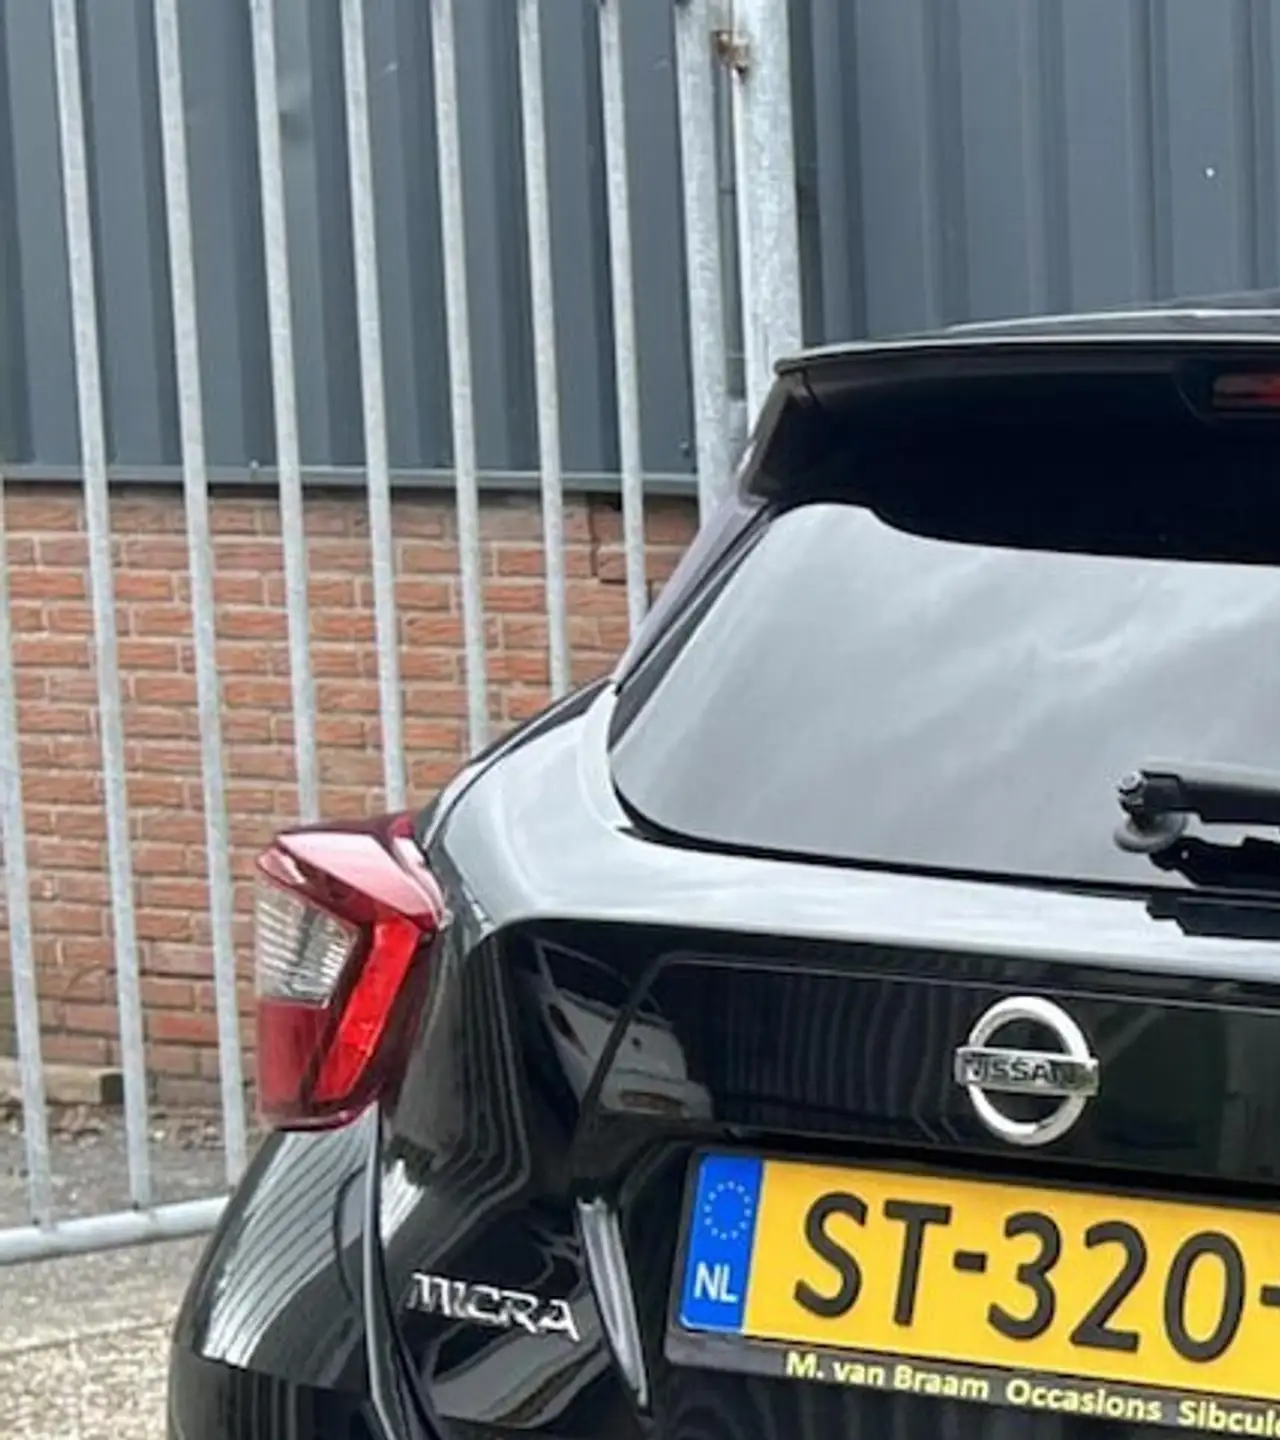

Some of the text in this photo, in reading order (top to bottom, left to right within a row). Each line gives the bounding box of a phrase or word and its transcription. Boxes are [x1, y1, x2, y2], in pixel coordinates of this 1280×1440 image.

[961, 1054, 1083, 1084] NISSAN
[406, 1272, 580, 1342] MICRA
[694, 1262, 738, 1302] NL
[786, 1353, 824, 1381] M.
[833, 1363, 886, 1387] van
[893, 1364, 991, 1399] Braam
[1005, 1379, 1163, 1421] Occasions
